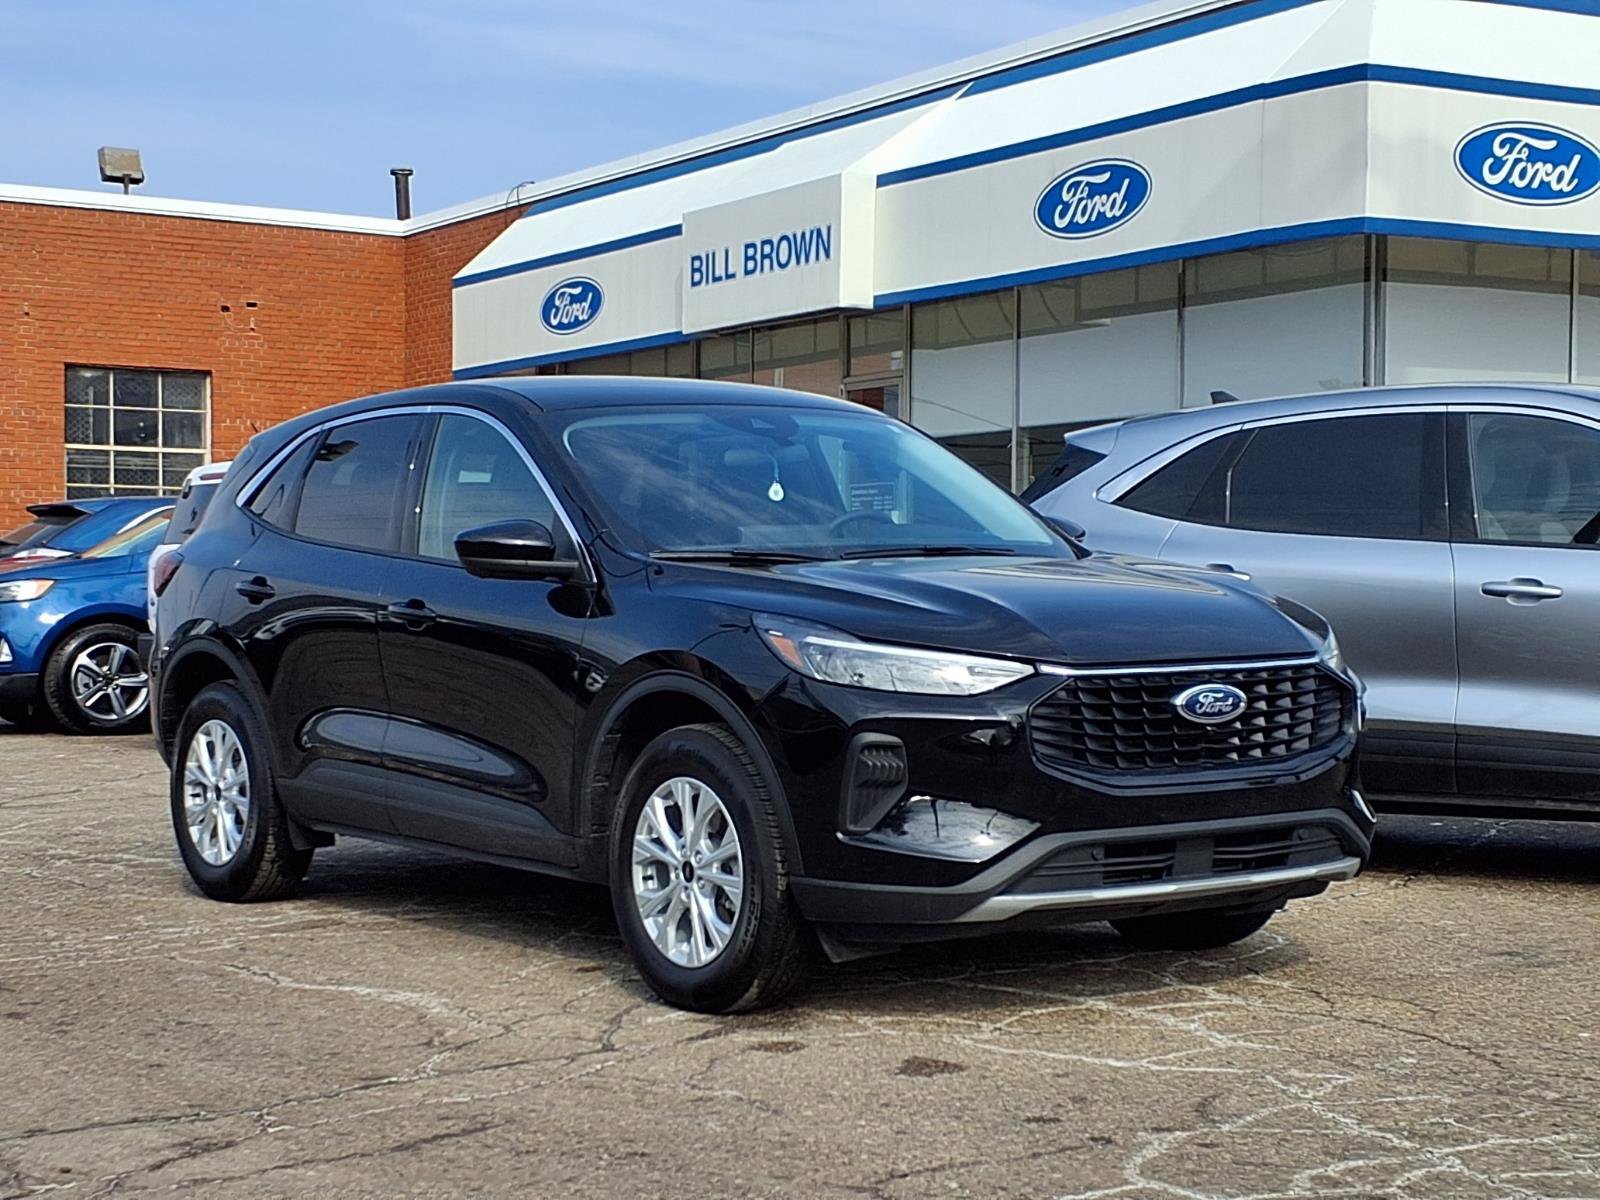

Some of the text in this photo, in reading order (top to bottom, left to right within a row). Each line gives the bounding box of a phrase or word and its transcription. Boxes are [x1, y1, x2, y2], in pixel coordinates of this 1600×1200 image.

[1482, 132, 1581, 192] Ford
[1054, 171, 1130, 228] Ford
[690, 223, 832, 288] BILL BROWN
[550, 286, 593, 326] Ford
[1195, 692, 1234, 714] Ford
